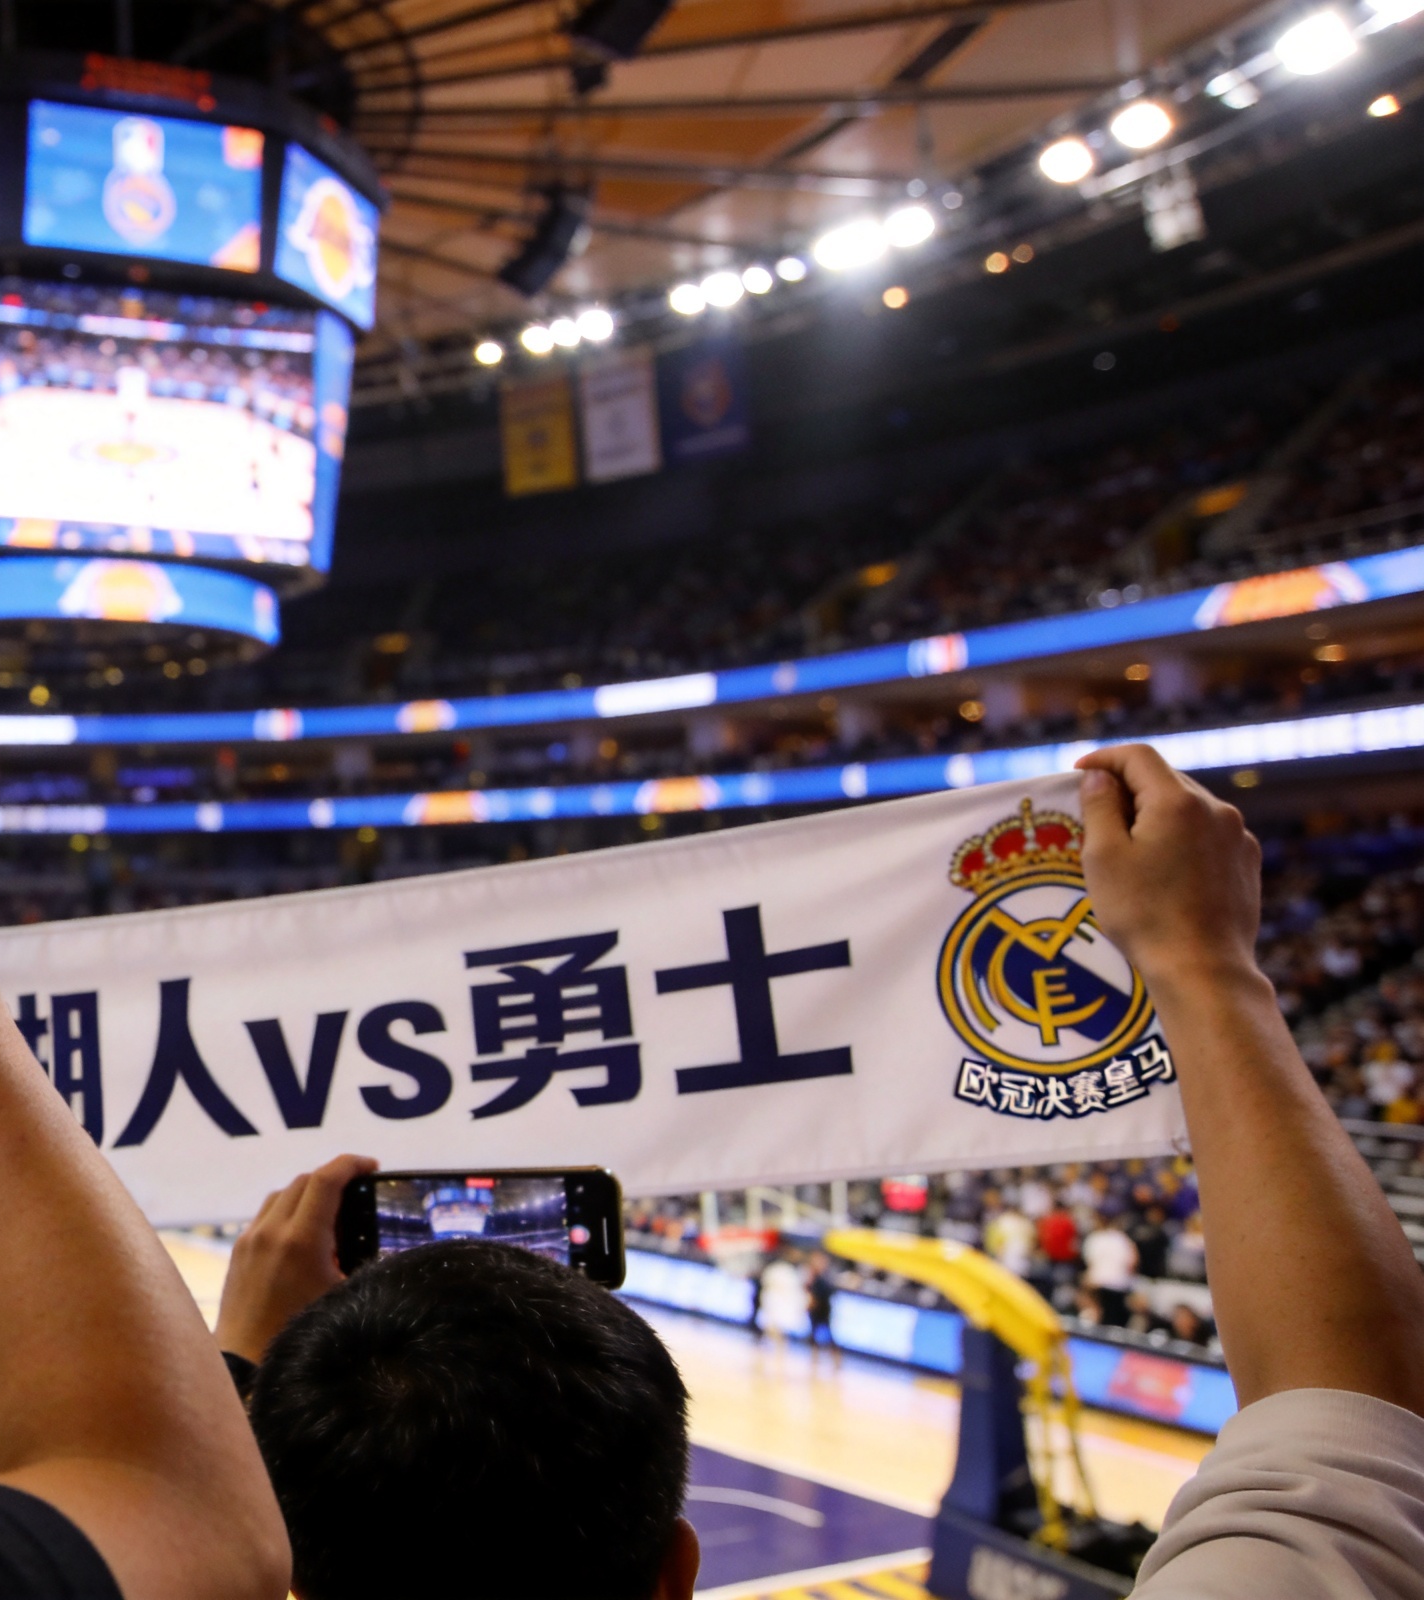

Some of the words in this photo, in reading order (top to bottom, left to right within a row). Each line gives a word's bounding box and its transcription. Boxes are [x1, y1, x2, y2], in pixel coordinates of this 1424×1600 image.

[956, 1034, 1174, 1118] 欧冠决赛皇马
